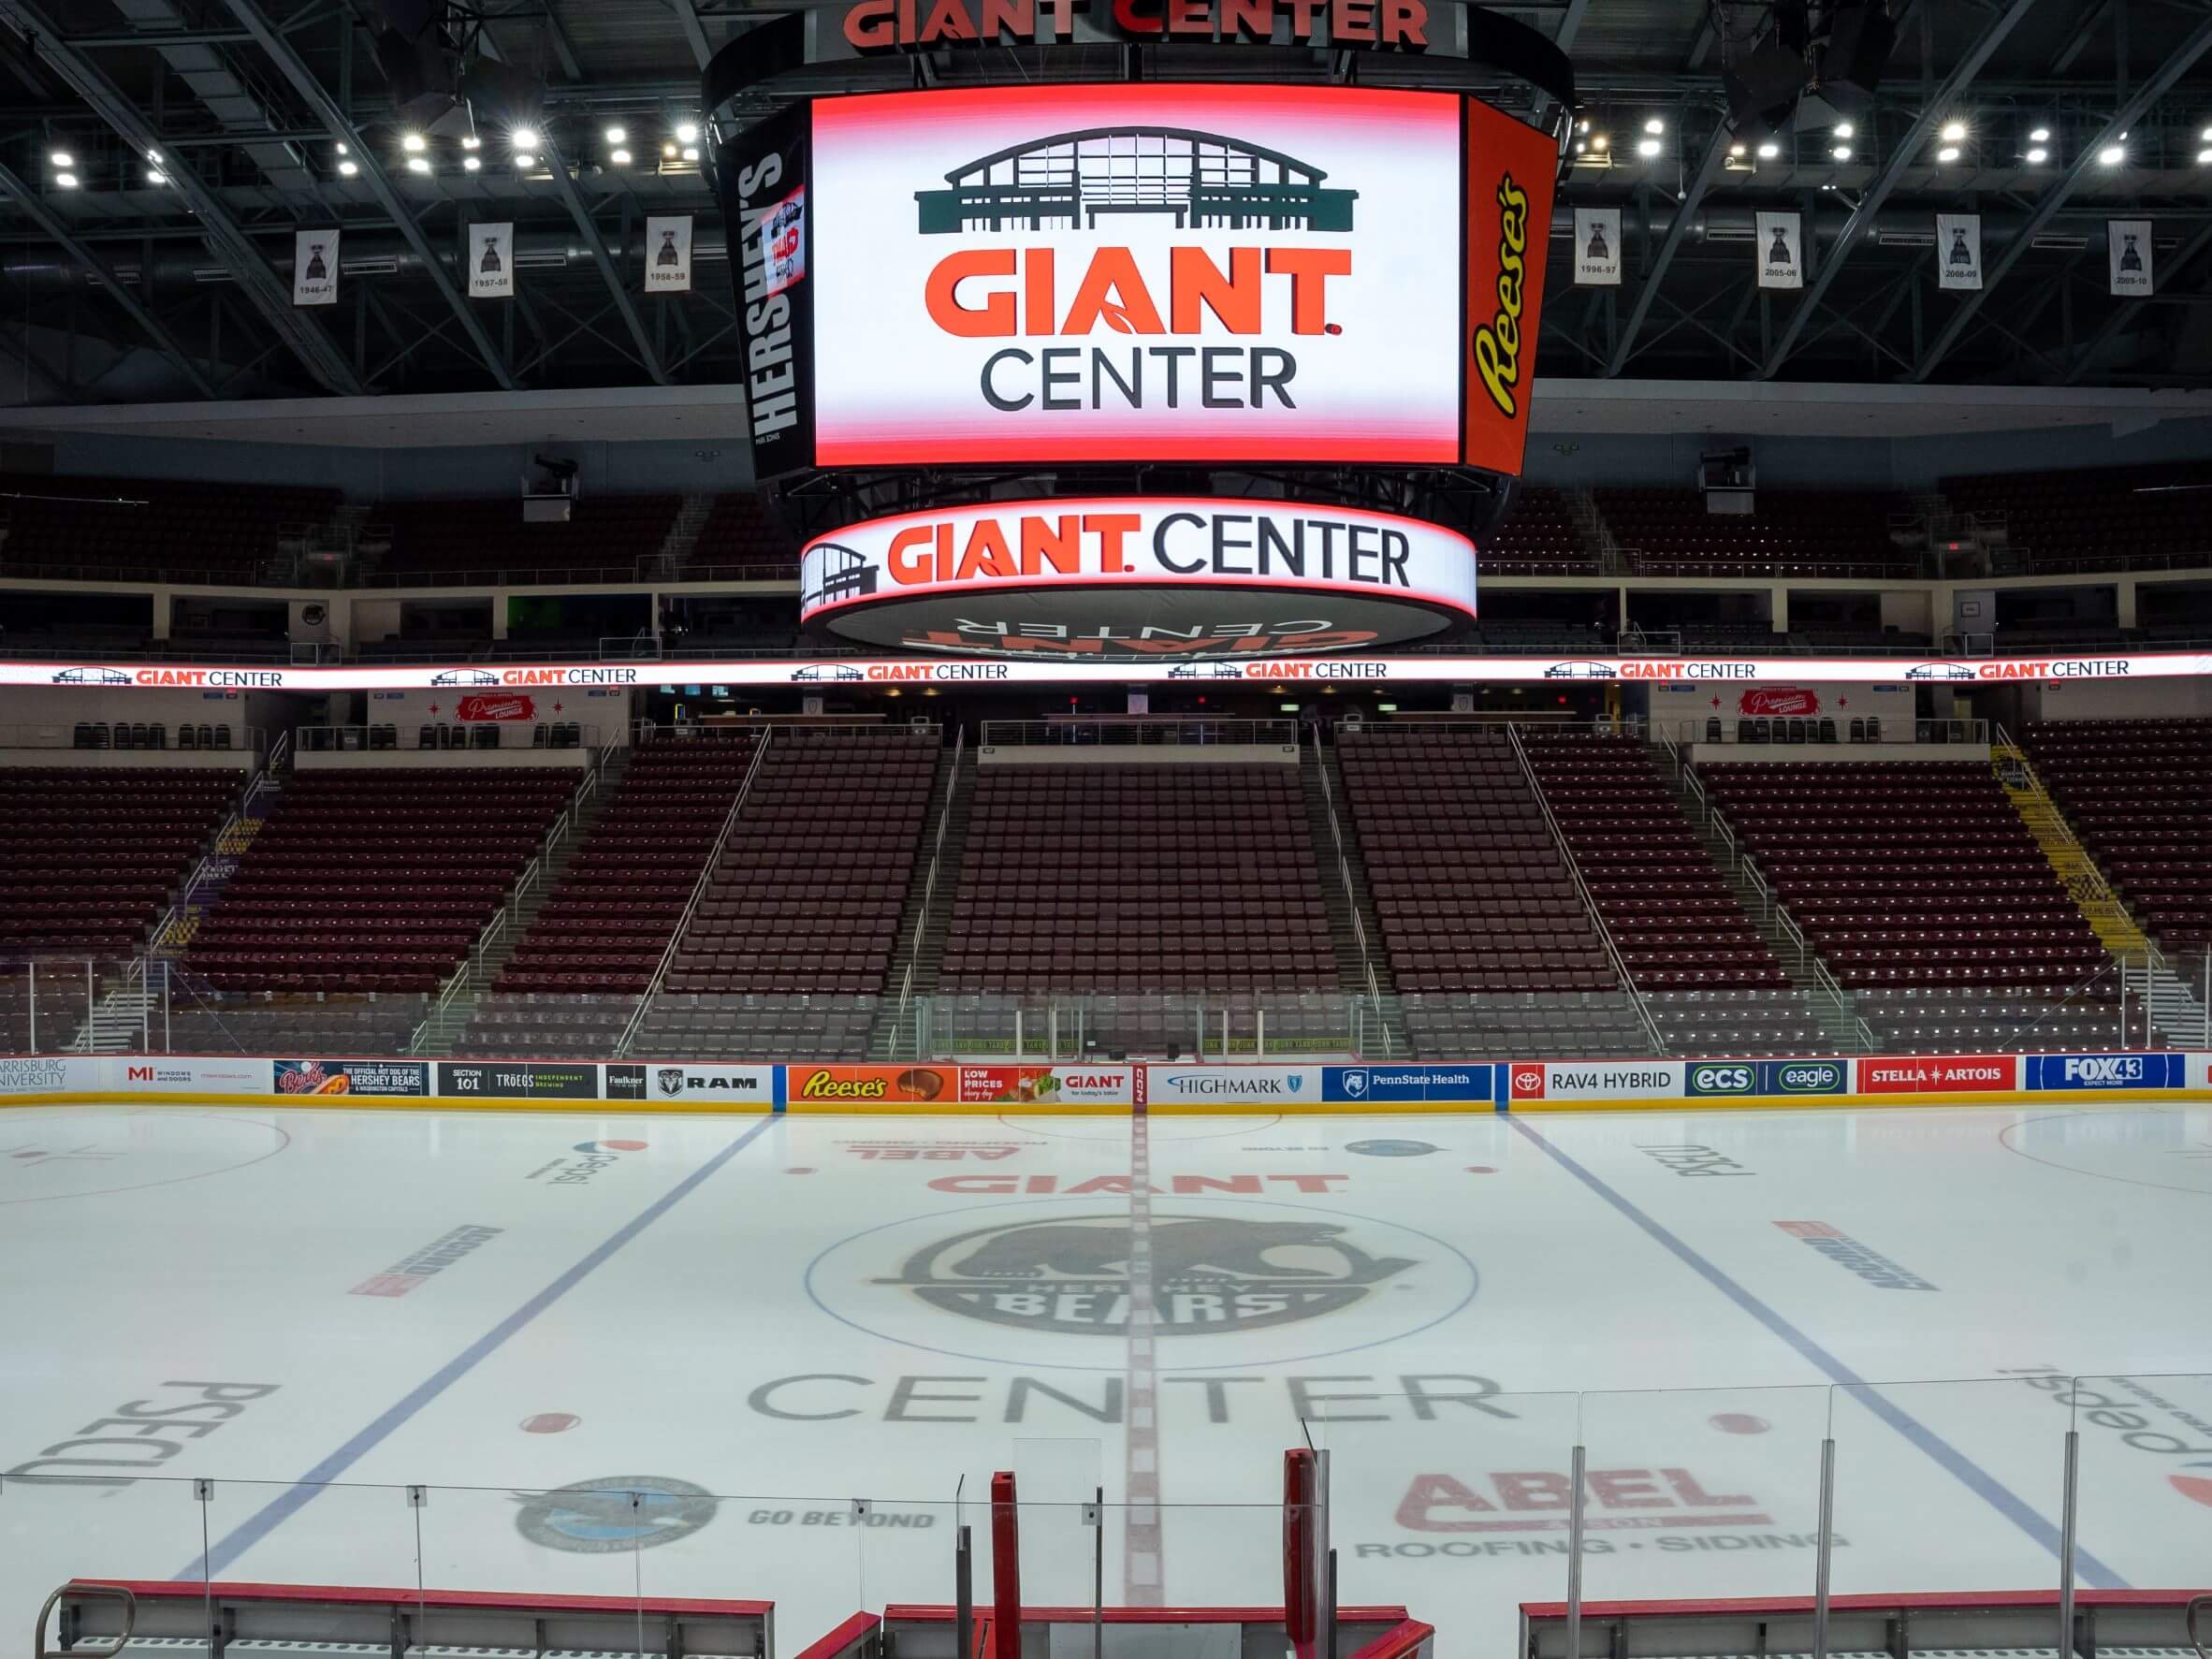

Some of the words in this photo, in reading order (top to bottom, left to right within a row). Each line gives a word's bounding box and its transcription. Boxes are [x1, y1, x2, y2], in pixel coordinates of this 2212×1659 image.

[843, 0, 1072, 50] GIANT
[1114, 0, 1430, 48] CENTER
[924, 245, 1353, 338] GIANT
[1473, 172, 1532, 420] Reese's
[980, 347, 1298, 412] CENTER
[887, 512, 1142, 585] GIANT
[1152, 512, 1411, 587] CENTER
[136, 670, 208, 686] GIANT
[209, 669, 284, 687] CENTER
[502, 669, 566, 684] GIANT
[568, 668, 637, 684] CENTER
[867, 664, 935, 680] GIANT
[937, 664, 1008, 680] CENTER
[1245, 662, 1314, 677] GIANT
[1316, 662, 1388, 678] CENTER
[1620, 662, 1685, 678] GIANT
[1687, 663, 1756, 678] CENTER
[1979, 662, 2050, 678] GIANT
[2052, 660, 2130, 677] CENTER
[128, 1067, 153, 1081] MI
[351, 1075, 390, 1085] HERSHEY
[392, 1076, 420, 1086] BEARS
[609, 1075, 644, 1084] Faulkner
[687, 1077, 757, 1088] RAM
[964, 1070, 988, 1078] LOW
[1066, 1075, 1124, 1088] GIANT
[1432, 1073, 1470, 1084] Health
[1552, 1074, 1598, 1089] RAV4
[1604, 1071, 1671, 1088] HYBRID
[1696, 1069, 1750, 1088] ecs
[1784, 1067, 1833, 1086] eagle
[1871, 1069, 1927, 1082] STELLA
[1944, 1068, 2001, 1081] ARTOIS
[456, 1079, 480, 1090] 101
[802, 1069, 888, 1098] Reese's
[964, 1080, 1003, 1088] PRICES
[1136, 1068, 1144, 1102] CCM
[1179, 1078, 1281, 1094] HIGHMARK
[926, 1174, 1349, 1194] GIANT
[994, 1292, 1288, 1325] BEARS
[747, 1373, 1521, 1424] CENTER
[1395, 1467, 1757, 1513] ABEL
[747, 1508, 795, 1526] GO
[800, 1509, 936, 1529] BEYOND
[1354, 1537, 1617, 1559] ROOFING
[1654, 1533, 1851, 1554] SIDING
